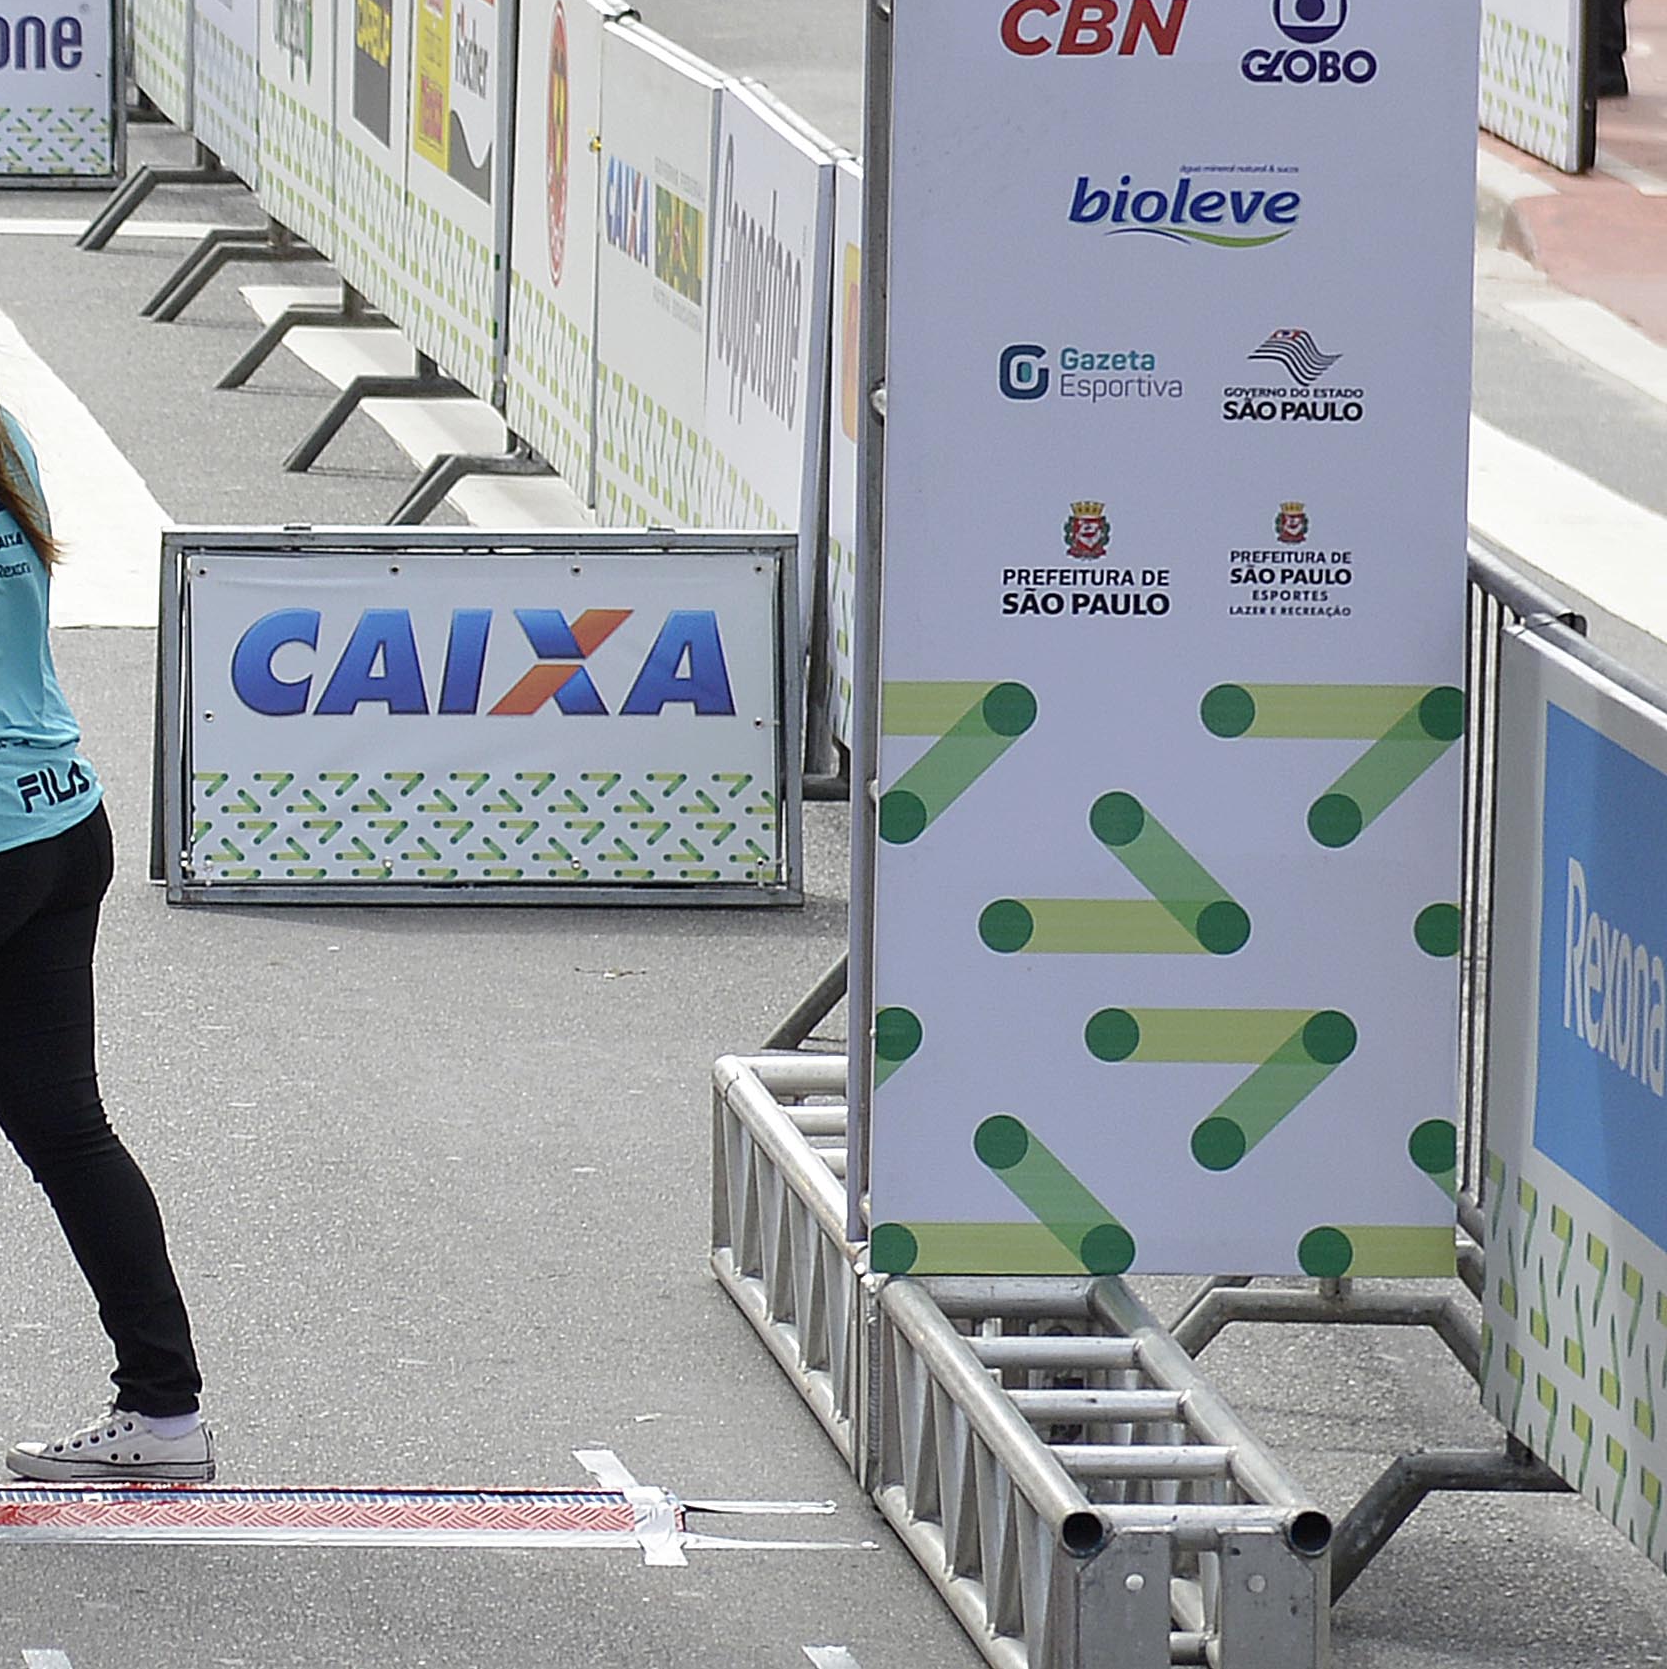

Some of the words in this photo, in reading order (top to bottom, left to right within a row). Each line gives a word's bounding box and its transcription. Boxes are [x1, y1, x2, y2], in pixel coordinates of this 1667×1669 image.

[1241, 48, 1378, 84] GLOBO
[605, 156, 649, 268] CAIXA
[1068, 174, 1301, 225] bioleve
[718, 134, 802, 430] Coppertone
[1060, 348, 1155, 371] Gazeta
[1060, 374, 1182, 403] Esportiva
[1224, 388, 1286, 398] GOVERNO
[1290, 388, 1310, 398] DO
[1313, 388, 1363, 398] ESTADO
[1223, 398, 1277, 421] SÃO
[1281, 402, 1363, 421] PAULO
[1230, 551, 1326, 564] PREFEITURA
[1330, 551, 1351, 564] DE
[1002, 569, 1134, 586] PREFEITURA
[1142, 569, 1169, 586] DE
[1230, 565, 1275, 584] SÃO
[1280, 568, 1351, 585] PAULO
[1002, 588, 1065, 615] SÃO
[1072, 593, 1169, 615] PAULO
[1252, 590, 1328, 601] ESPORTES
[1229, 606, 1267, 616] LAZER
[1280, 604, 1351, 618] RECREAÇÃO
[231, 608, 736, 716] CAIXA
[17, 760, 91, 814] FILA
[1564, 857, 1667, 1097] Rexona
